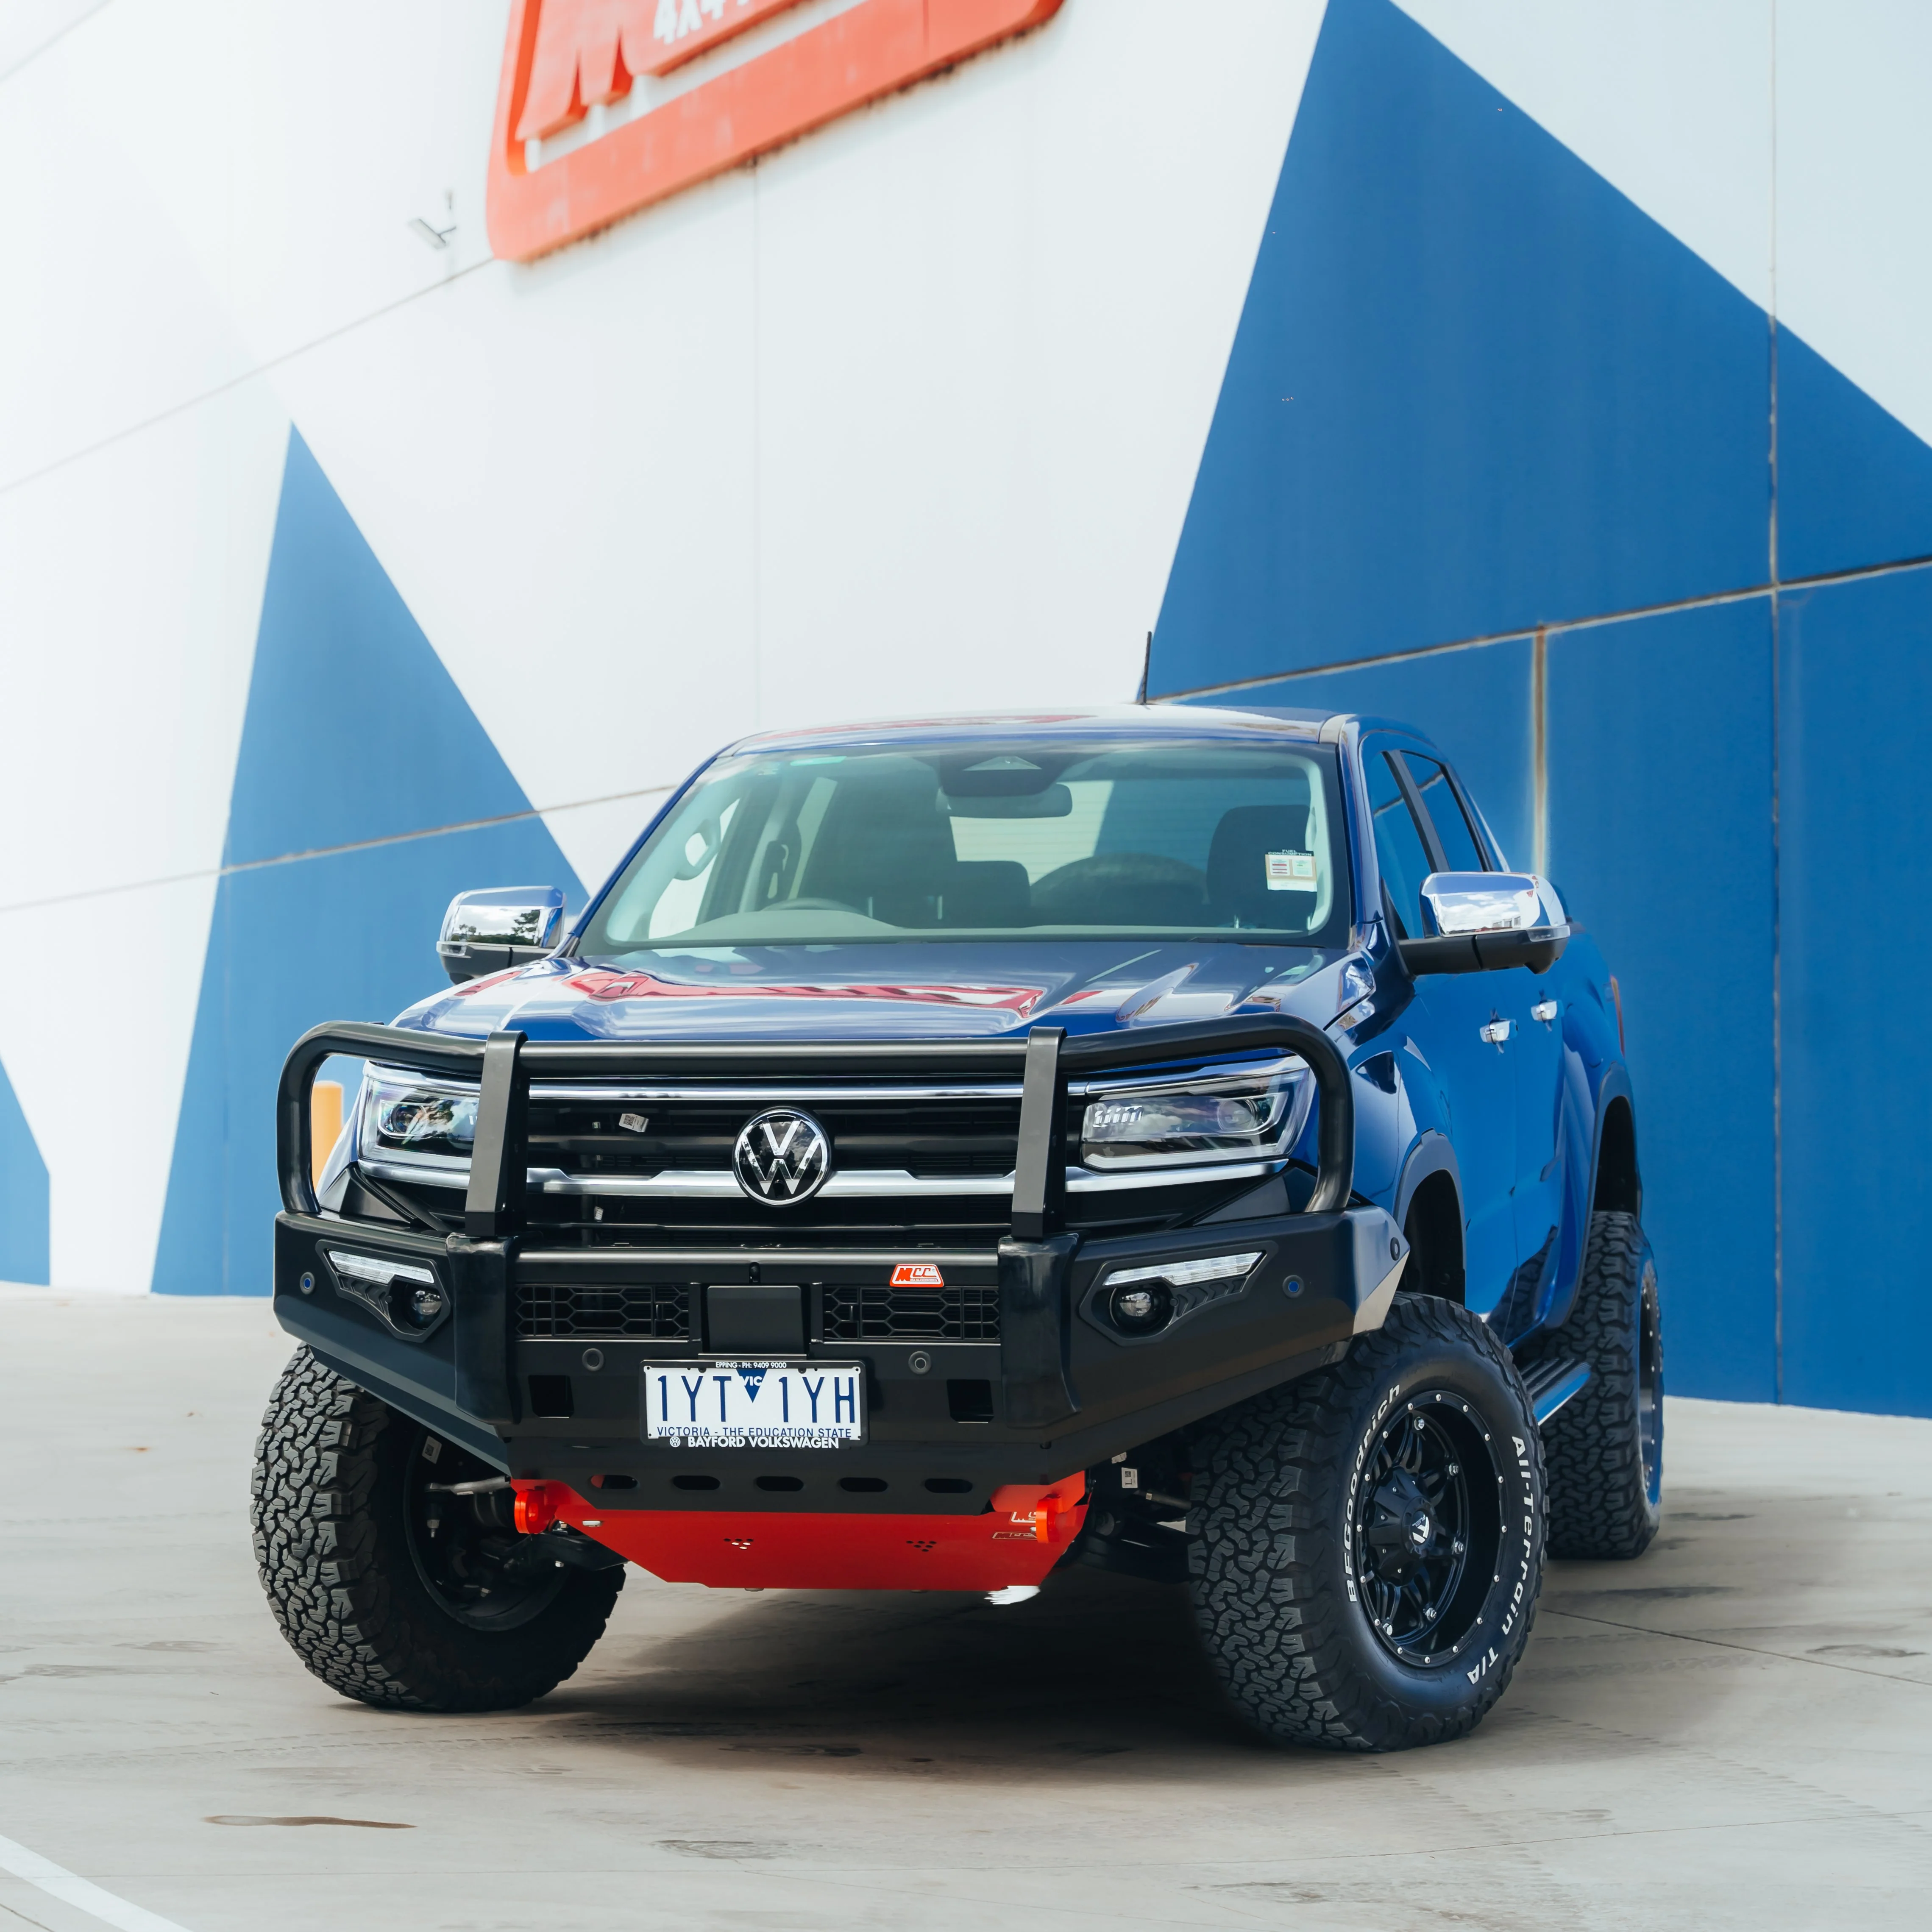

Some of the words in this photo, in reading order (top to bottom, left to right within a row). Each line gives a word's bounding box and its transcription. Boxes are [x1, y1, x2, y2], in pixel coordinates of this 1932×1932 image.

[895, 1268, 937, 1281] MCC
[742, 1376, 763, 1386] VIC
[657, 1375, 732, 1422] 1YT
[779, 1376, 855, 1423] 1YH
[657, 1427, 710, 1436] VICTORIA
[723, 1427, 744, 1436] THE
[749, 1428, 813, 1437] EDUCATION
[818, 1428, 852, 1438] STATE
[688, 1436, 746, 1448] BAYFORD
[749, 1437, 839, 1449] VOLKSWAGEN
[1343, 1383, 1400, 1602] BFGoodrich
[1502, 1436, 1534, 1635] All-Terrain
[1467, 1647, 1499, 1685] T/A
